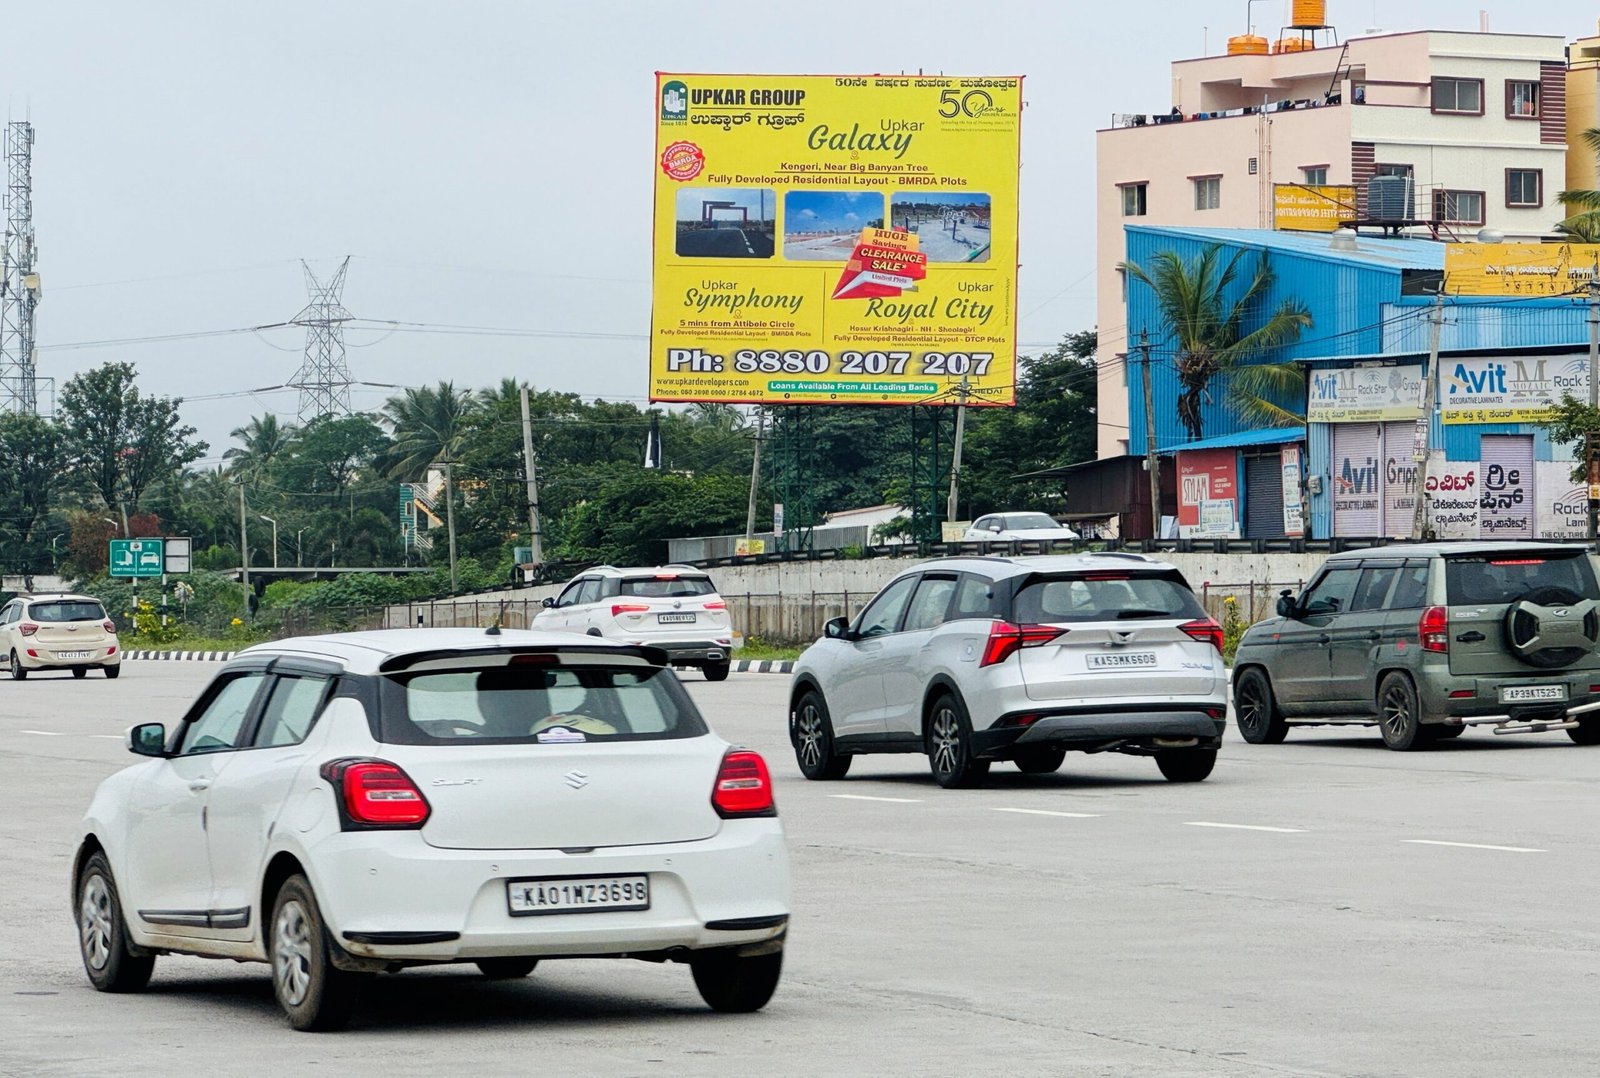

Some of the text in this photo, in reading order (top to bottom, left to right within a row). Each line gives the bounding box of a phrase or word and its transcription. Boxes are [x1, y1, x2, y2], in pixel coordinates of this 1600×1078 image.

[692, 89, 806, 106] UPKAR GROUP
[938, 90, 993, 118] 50
[758, 113, 804, 130] ಗ್ರೂಪ್
[880, 120, 924, 135] Upkar
[808, 123, 914, 160] Galaxy
[669, 155, 696, 168] BMRDA
[781, 162, 821, 172] Kengeri,
[850, 164, 865, 172] Big
[868, 164, 904, 172] Banyan
[708, 174, 732, 184] Fully
[736, 175, 790, 184] Developed
[793, 176, 850, 184] Residential
[854, 176, 888, 186] Layout
[898, 177, 938, 185] BMRDA
[940, 176, 967, 186] Plots
[874, 230, 908, 241] HUGE
[872, 239, 906, 250] Savings
[860, 248, 924, 263] CLEARANCE
[702, 280, 738, 291] Upkar
[958, 282, 994, 294] Upkar
[684, 287, 804, 314] Symphony
[864, 296, 938, 325] Royal
[946, 298, 994, 325] City
[668, 348, 994, 376] Ph: 8880 207 207
[656, 378, 749, 387] www.upkardevelopers.com
[1450, 363, 1507, 394] Avit
[1554, 374, 1582, 387] Rock
[874, 384, 906, 392] Leading
[1312, 374, 1337, 400] Avit
[1358, 385, 1373, 394] Rock
[1374, 384, 1387, 394] Star
[1340, 457, 1378, 494] Avit
